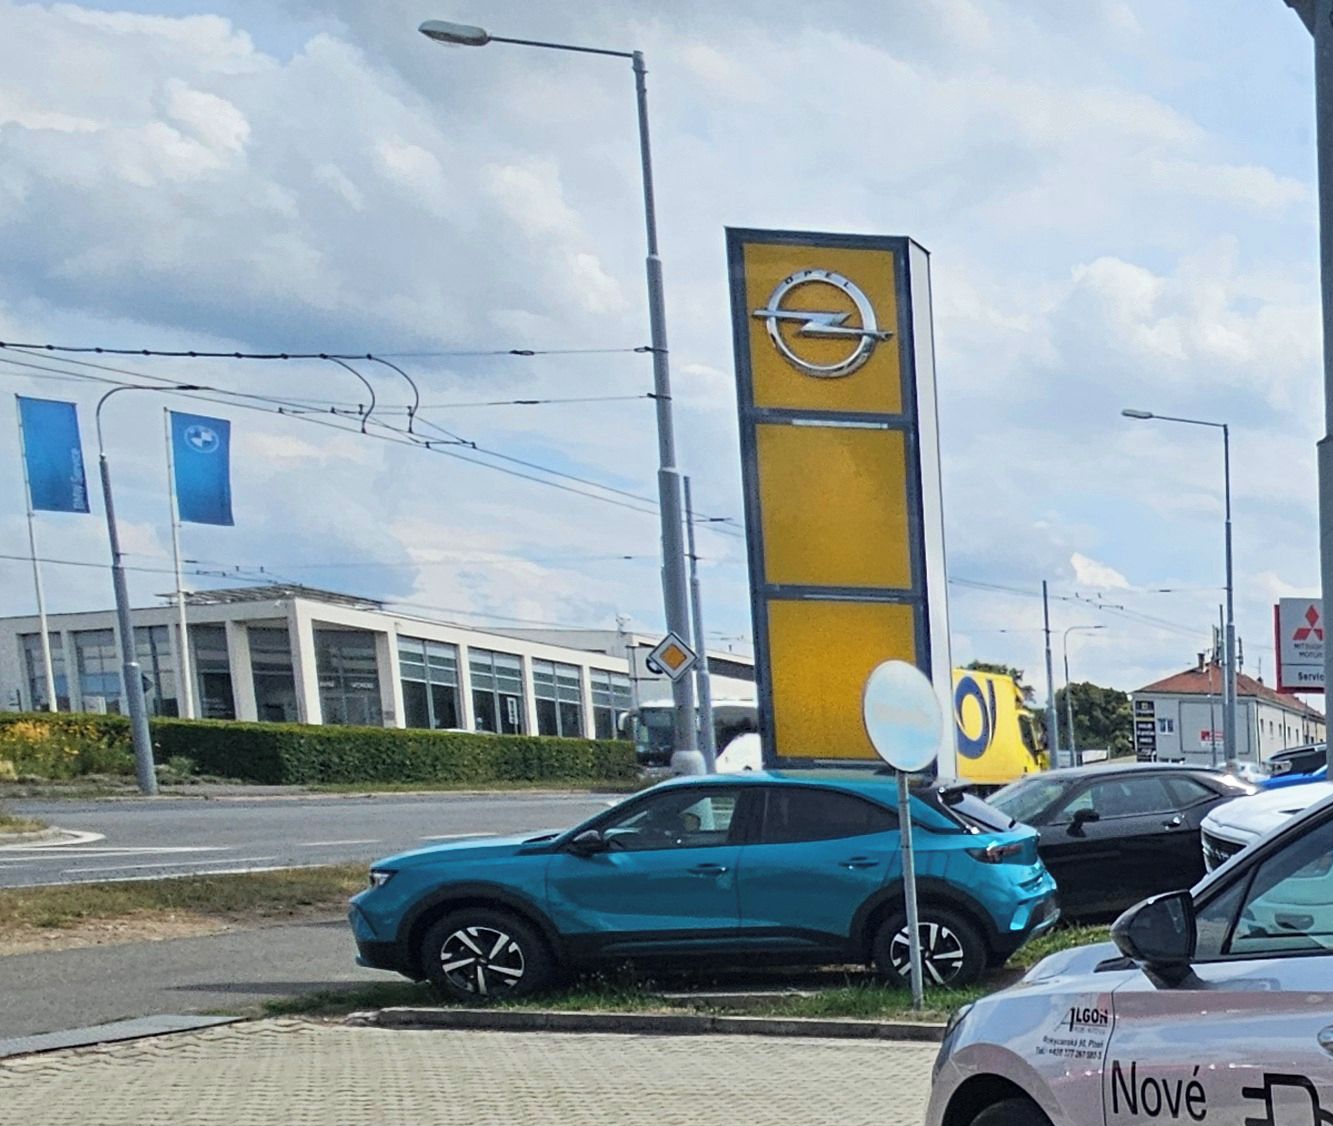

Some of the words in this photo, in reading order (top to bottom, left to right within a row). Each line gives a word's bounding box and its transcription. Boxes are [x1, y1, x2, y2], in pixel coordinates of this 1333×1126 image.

[784, 269, 850, 288] OPEL
[1298, 671, 1325, 682] Servic
[1111, 1060, 1206, 1121] Nové
